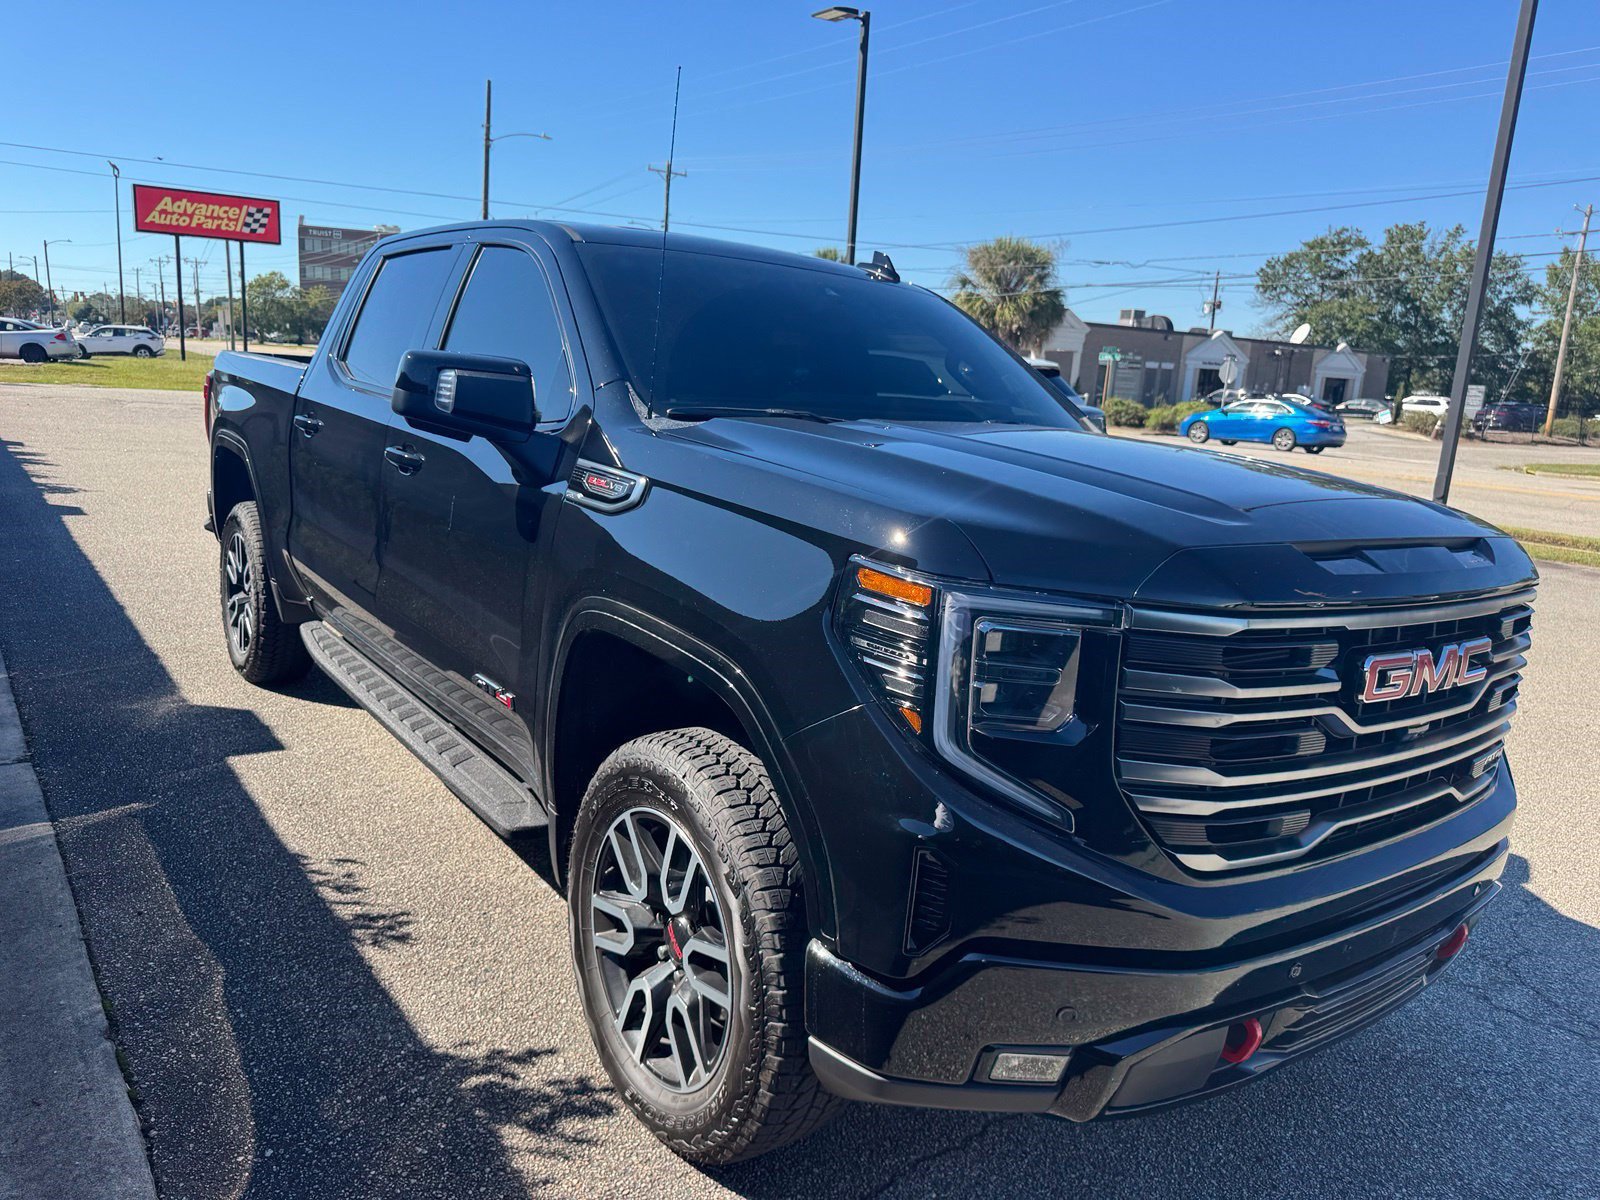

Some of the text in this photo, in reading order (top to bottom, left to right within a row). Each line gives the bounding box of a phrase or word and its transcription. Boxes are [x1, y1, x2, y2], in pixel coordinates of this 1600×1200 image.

[145, 210, 237, 231] Auto Parts
[154, 196, 240, 219] Advance
[1363, 637, 1493, 703] GMC
[624, 1082, 728, 1131] BRIDGESTONE
